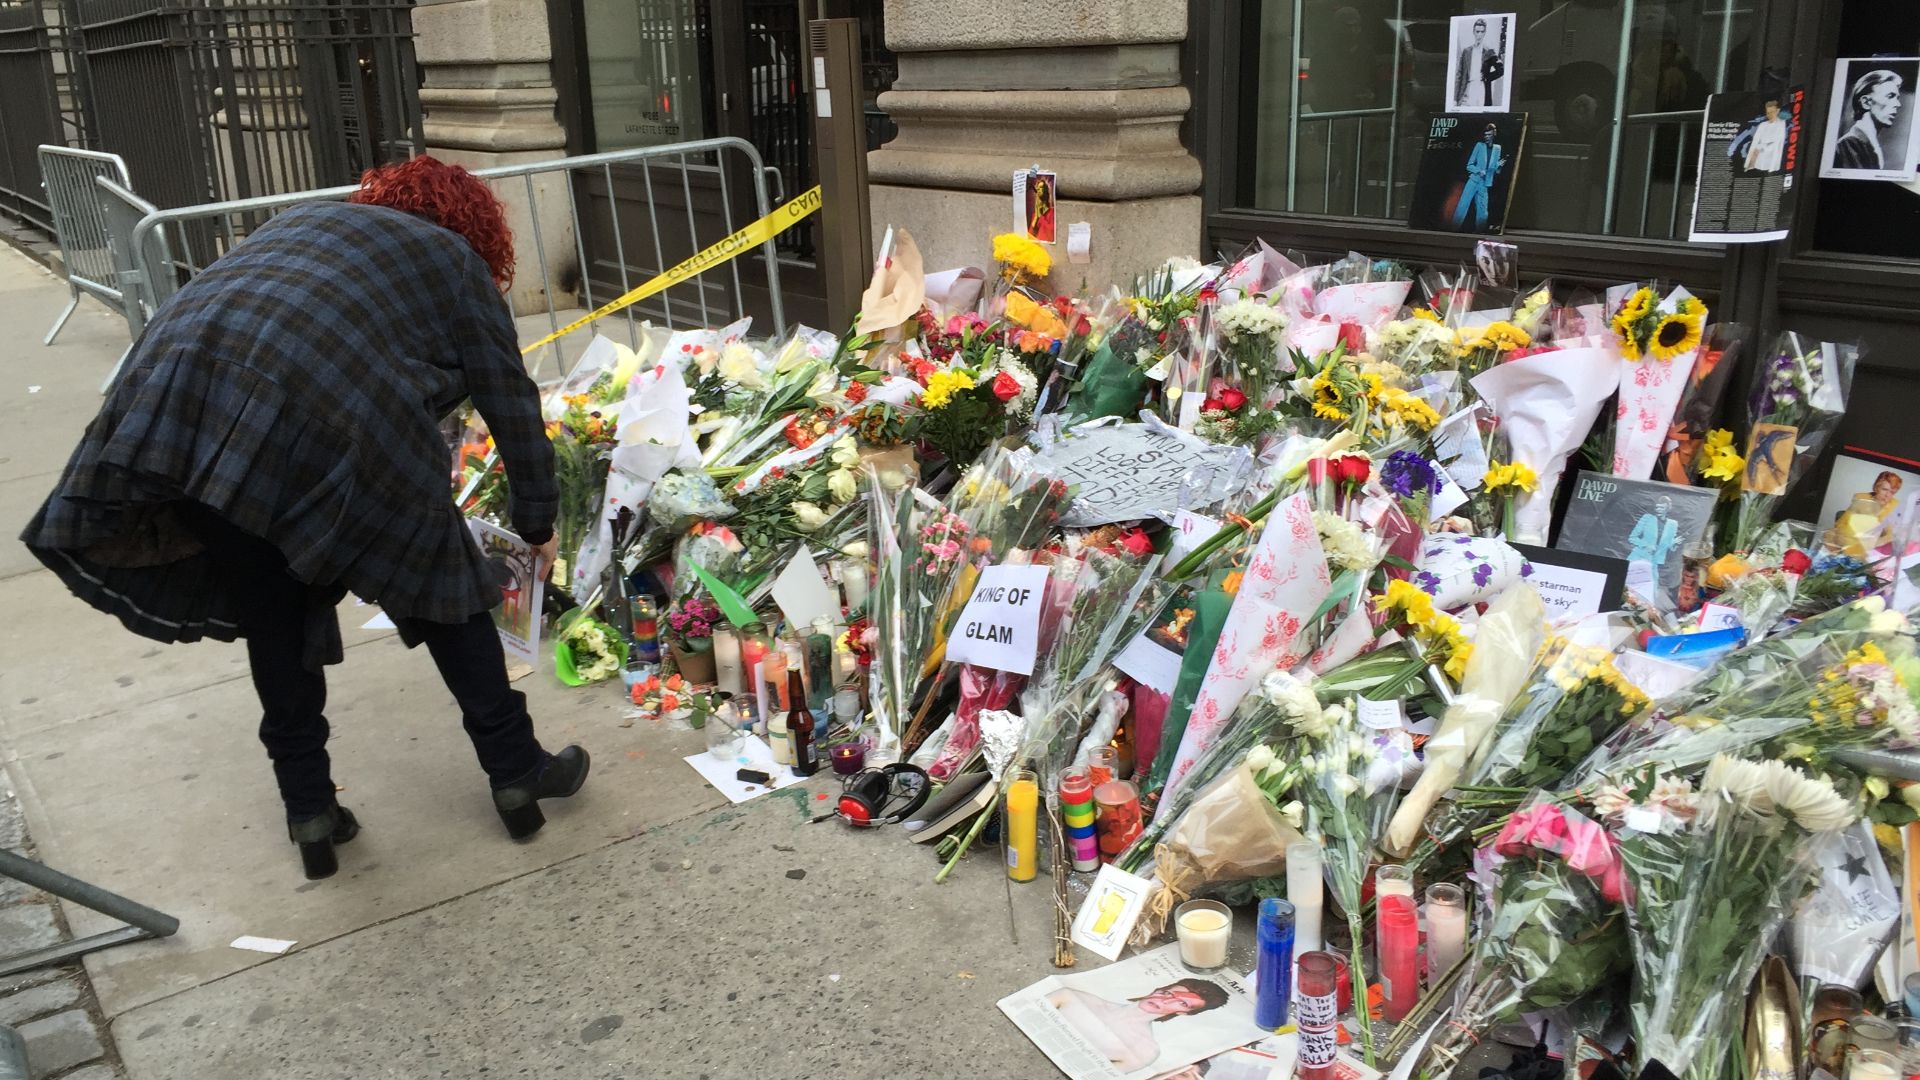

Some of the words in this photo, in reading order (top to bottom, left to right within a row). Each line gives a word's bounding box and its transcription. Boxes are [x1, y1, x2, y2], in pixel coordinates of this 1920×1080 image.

[1432, 117, 1458, 128] DAVID
[1429, 127, 1450, 138] LIVE
[1136, 429, 1187, 454] AND
[1096, 446, 1148, 476] LOOK
[1580, 478, 1618, 494] DAVID
[1577, 488, 1606, 502] LIVE
[1539, 580, 1582, 594] starman
[973, 586, 1006, 604] KING
[1007, 587, 1031, 606] OF
[965, 621, 1014, 645] GLAM
[1228, 979, 1248, 995] Arts
[1306, 1043, 1332, 1054] RIP
